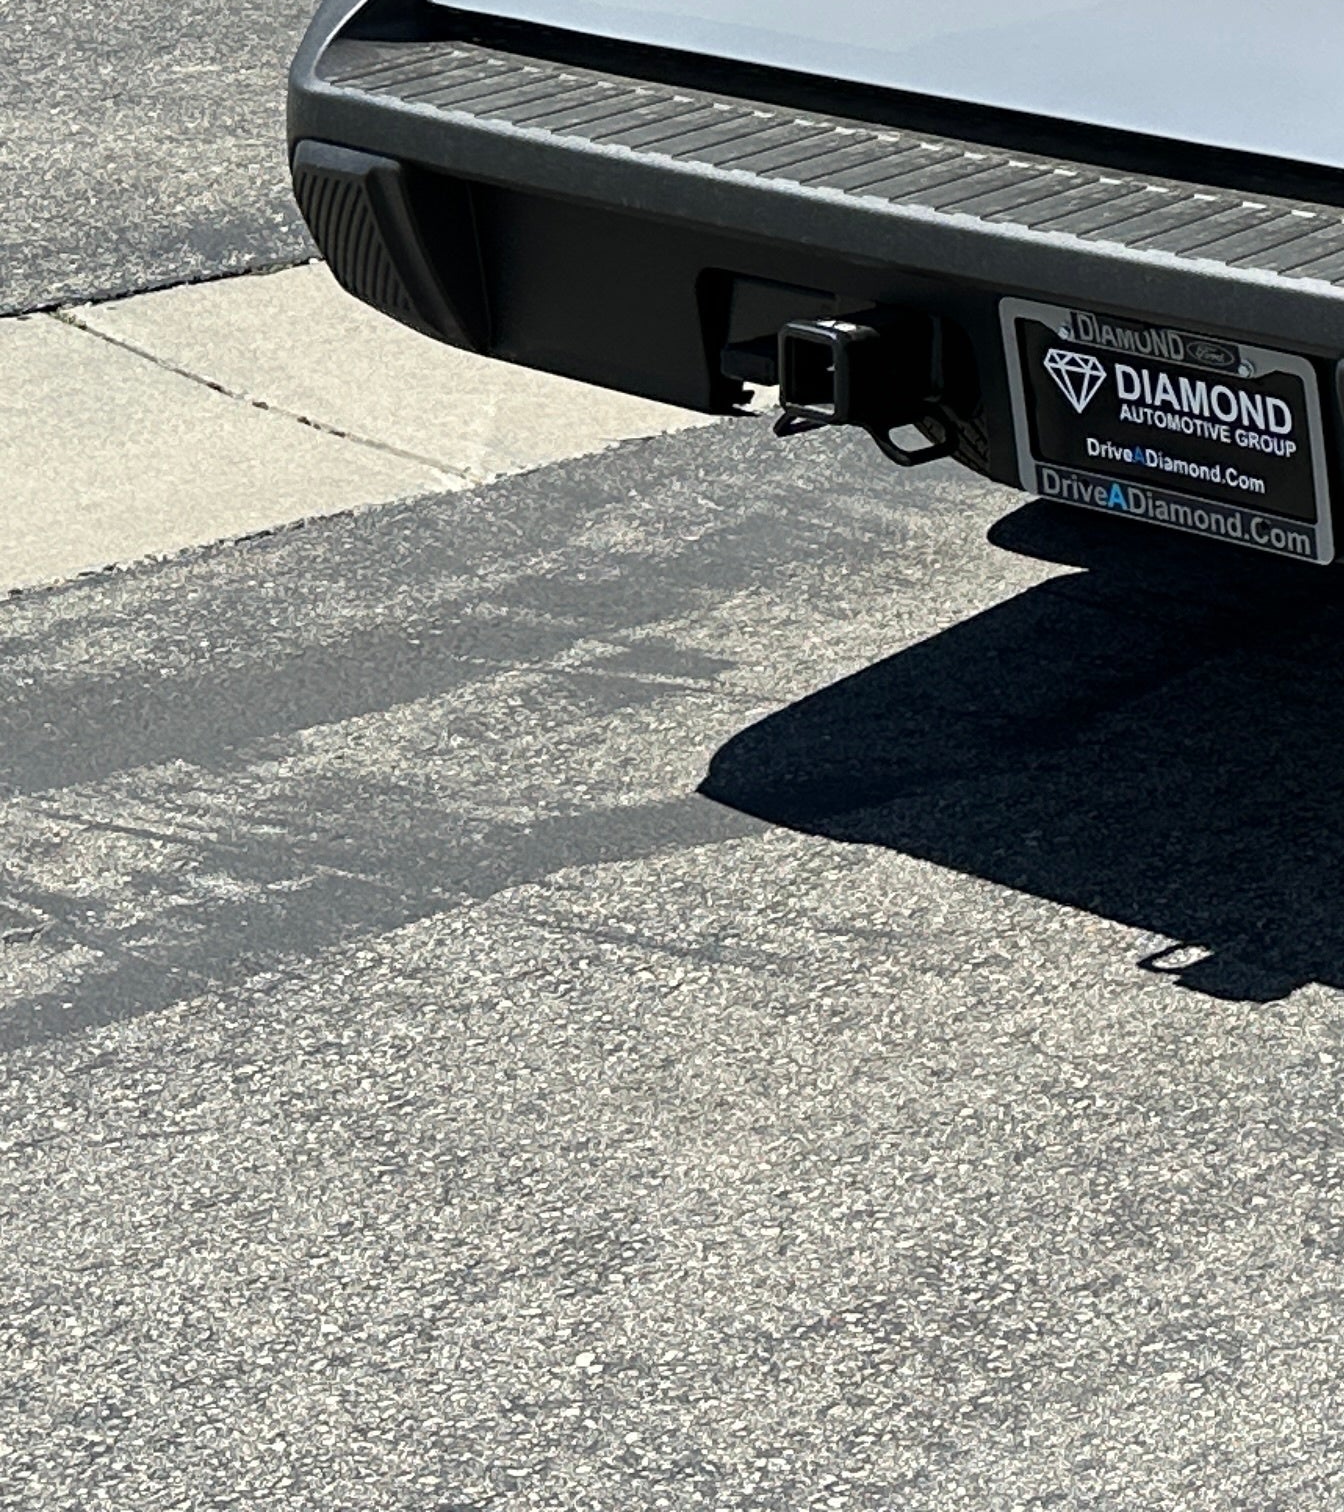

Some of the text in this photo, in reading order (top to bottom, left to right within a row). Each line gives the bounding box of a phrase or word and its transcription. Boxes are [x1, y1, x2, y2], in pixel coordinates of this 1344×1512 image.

[1075, 312, 1185, 361] DIAMOND
[1114, 362, 1292, 435] DIAMOND
[1119, 402, 1297, 458] AUTOMOTIVE GROUP
[1086, 437, 1266, 494] DriveADiamond.Com
[1041, 467, 1312, 556] DriveADiamond.Com
